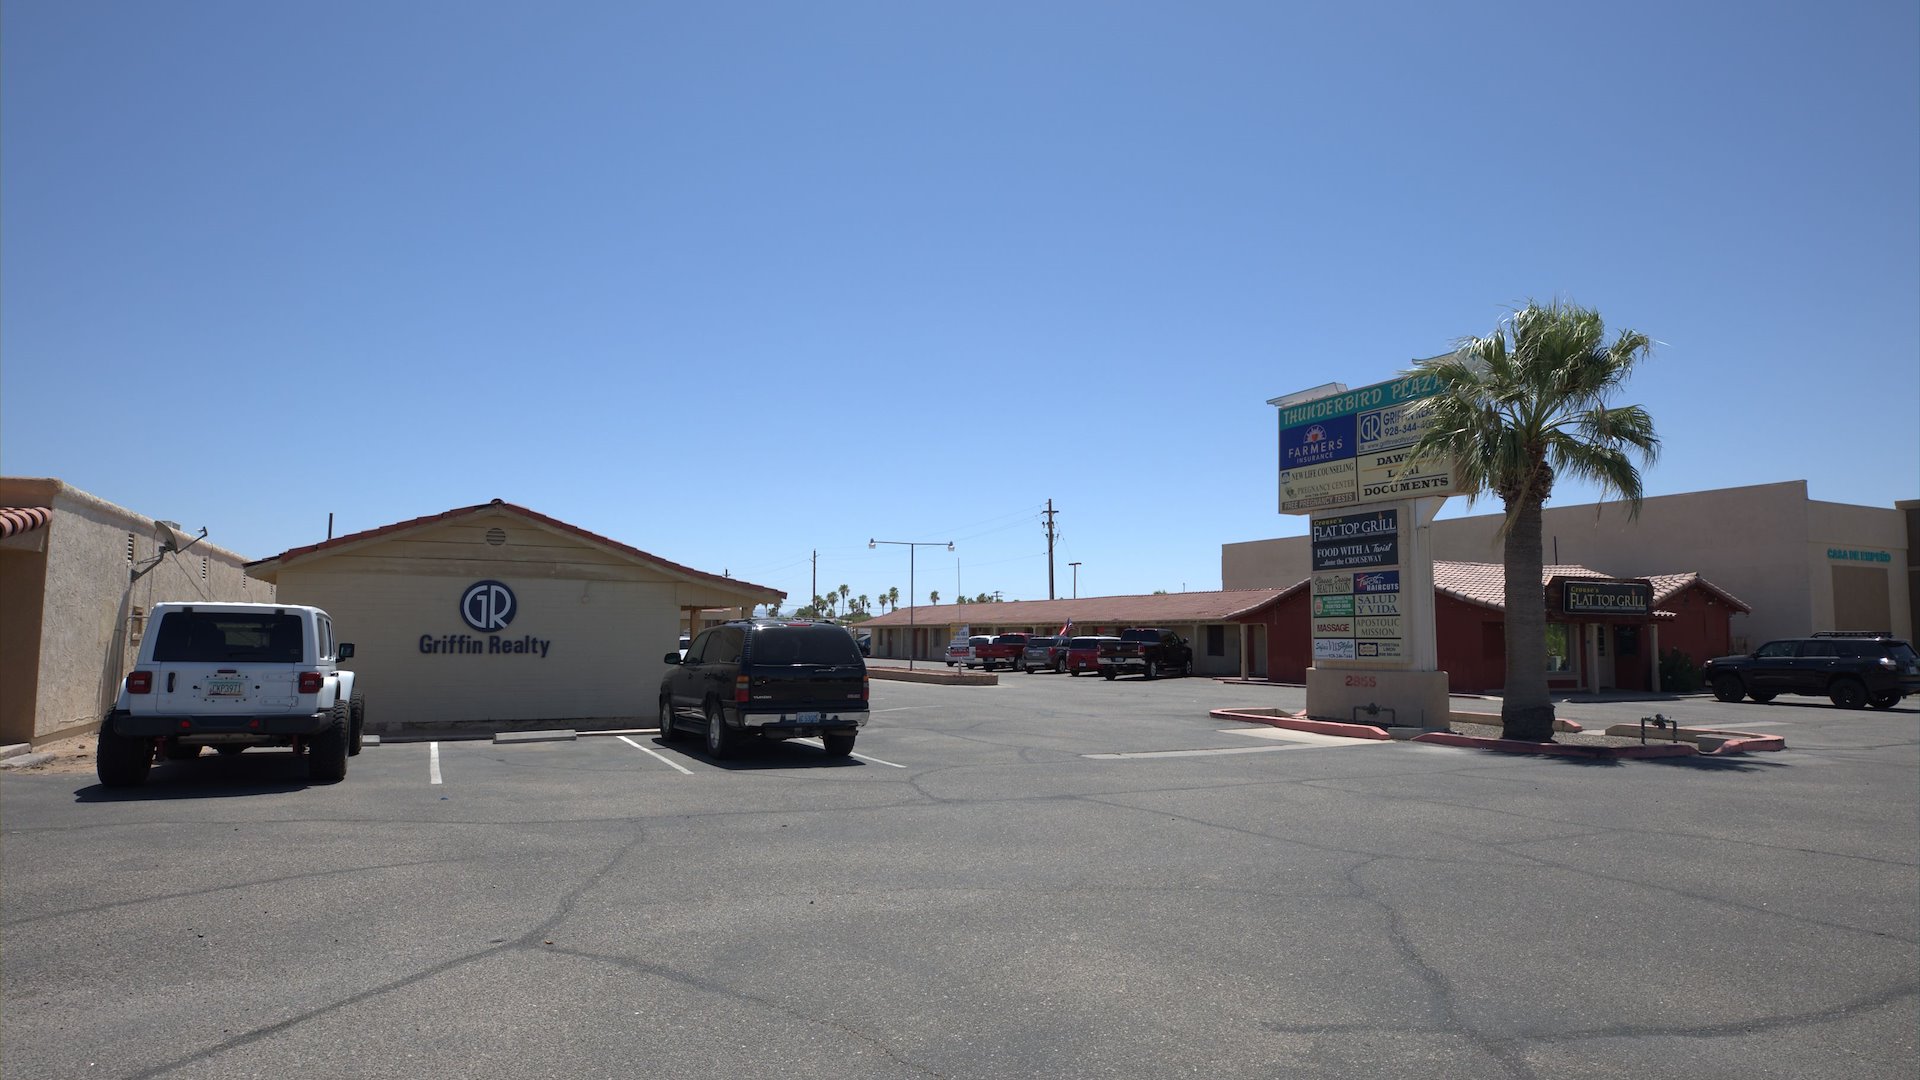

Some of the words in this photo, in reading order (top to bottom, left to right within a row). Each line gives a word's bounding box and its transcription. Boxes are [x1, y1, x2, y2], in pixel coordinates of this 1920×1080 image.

[1284, 388, 1382, 425] THUNDERBIRD
[1288, 439, 1343, 459] FARMERS
[1297, 451, 1333, 463] INSURANCE
[1291, 471, 1304, 480] NEW
[1305, 469, 1316, 478] LIFE
[1318, 462, 1354, 476] COUNSELING
[1298, 483, 1331, 495] PREGNANCY
[1332, 479, 1355, 490] CENTER
[1364, 477, 1449, 496] DOCUMENTS
[1285, 501, 1299, 509] FREE
[1300, 495, 1333, 507] PREGNANCY
[1334, 493, 1353, 503] TESTS
[1313, 525, 1337, 542] FLAT
[1339, 522, 1360, 536] TOP
[1361, 518, 1396, 533] GRILL
[1317, 547, 1339, 558] FOOD
[1340, 544, 1362, 556] WITH
[1363, 544, 1370, 553] A
[1371, 542, 1392, 553] Twist
[1827, 548, 1848, 560] CASA
[1849, 550, 1860, 560] DE
[1345, 555, 1382, 564] CROUSEWAY
[1317, 584, 1334, 593] BEAUTY
[1335, 583, 1351, 592] SALON
[1366, 583, 1399, 591] HAIRCUTS
[1358, 594, 1396, 604] SALUD
[1570, 593, 1594, 609] FLAT
[1596, 594, 1615, 606] TOP
[1617, 594, 1646, 607] GRILL
[1358, 605, 1365, 613] Y
[1368, 604, 1397, 613] VIDA
[1317, 624, 1350, 632] MASSAGE
[1357, 618, 1400, 627] APOSTOLIC
[419, 634, 483, 654] Griffin
[489, 635, 550, 658] Realty
